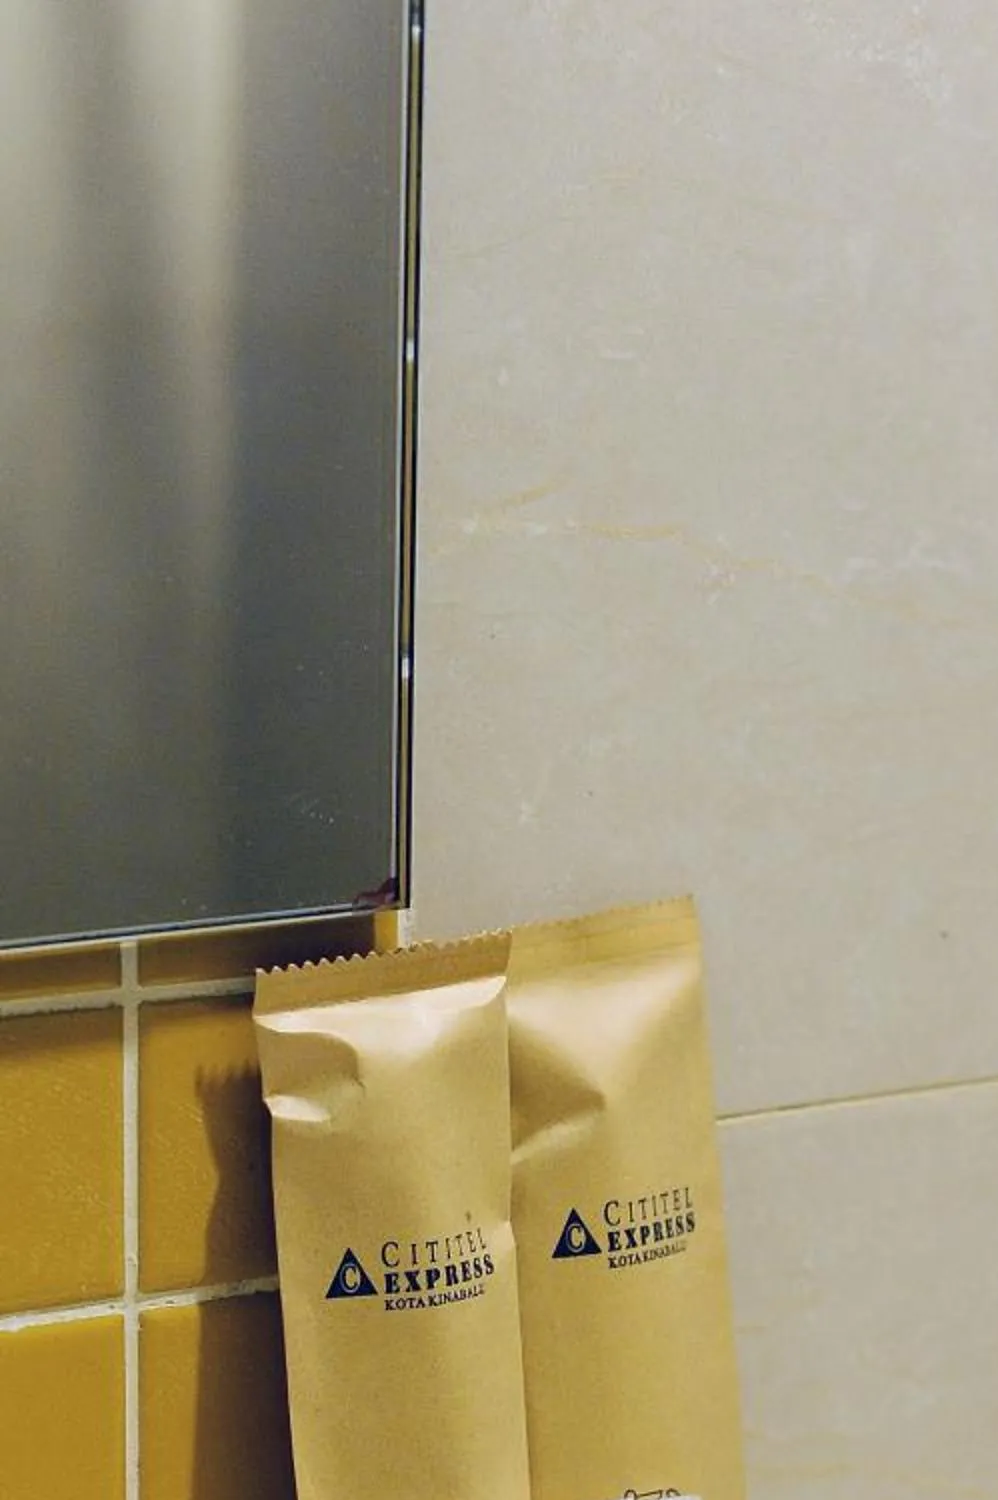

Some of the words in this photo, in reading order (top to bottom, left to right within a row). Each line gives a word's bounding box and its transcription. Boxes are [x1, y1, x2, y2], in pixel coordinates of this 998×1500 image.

[603, 1187, 693, 1226] CITITEL
[381, 1226, 487, 1268] CITITEL
[607, 1211, 695, 1252] EXPRESS
[384, 1254, 495, 1294] EXPRESS
[384, 1296, 426, 1311] KOTA
